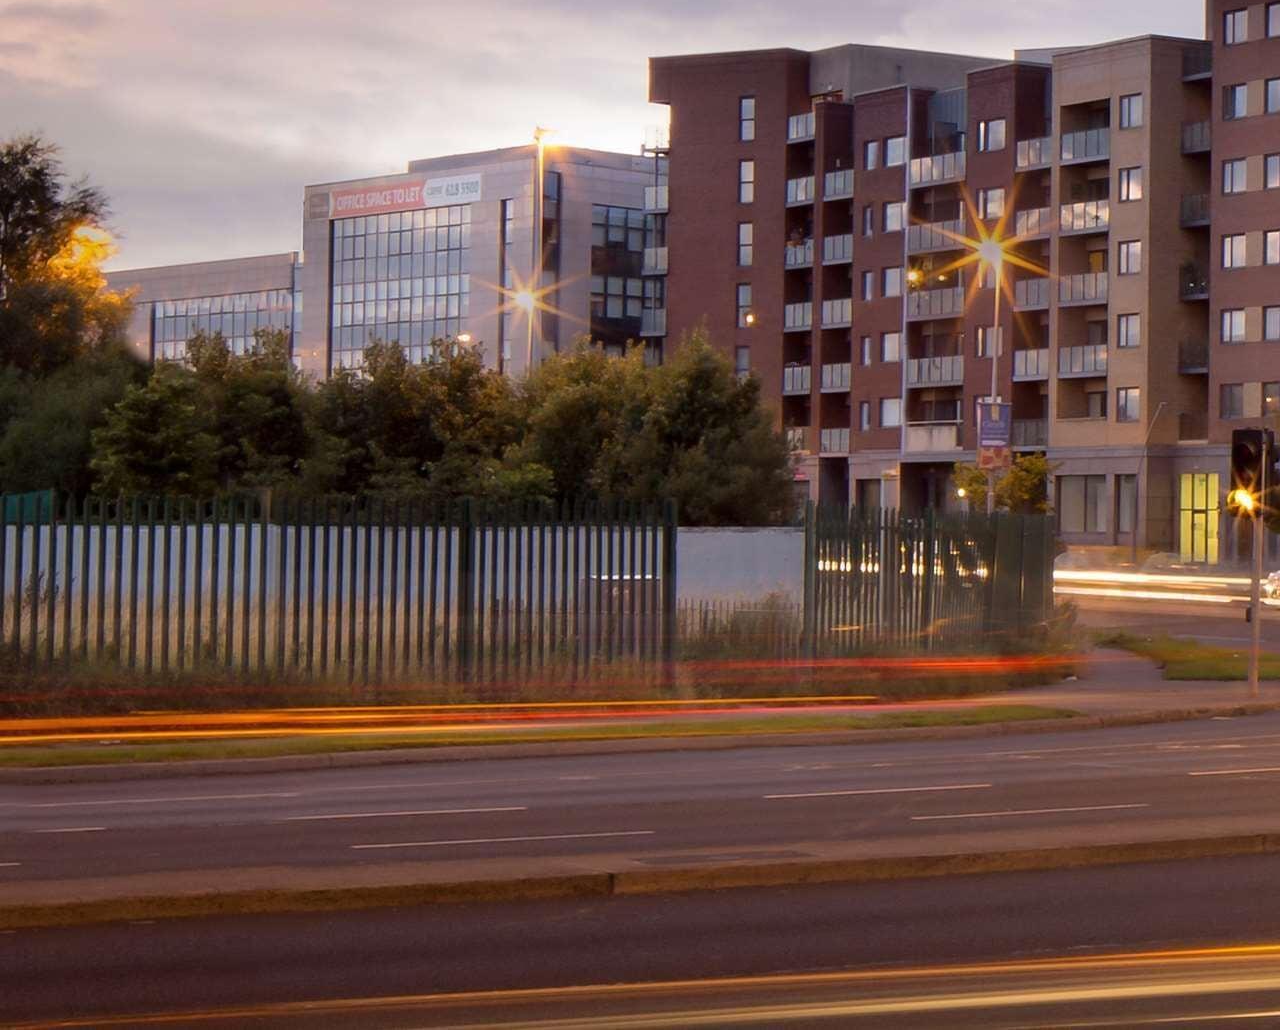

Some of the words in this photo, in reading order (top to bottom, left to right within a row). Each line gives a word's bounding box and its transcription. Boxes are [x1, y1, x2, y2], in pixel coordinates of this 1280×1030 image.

[336, 193, 365, 210] OFFICE
[366, 190, 391, 207] SPACE
[392, 188, 404, 204] TO
[405, 186, 421, 202] LET
